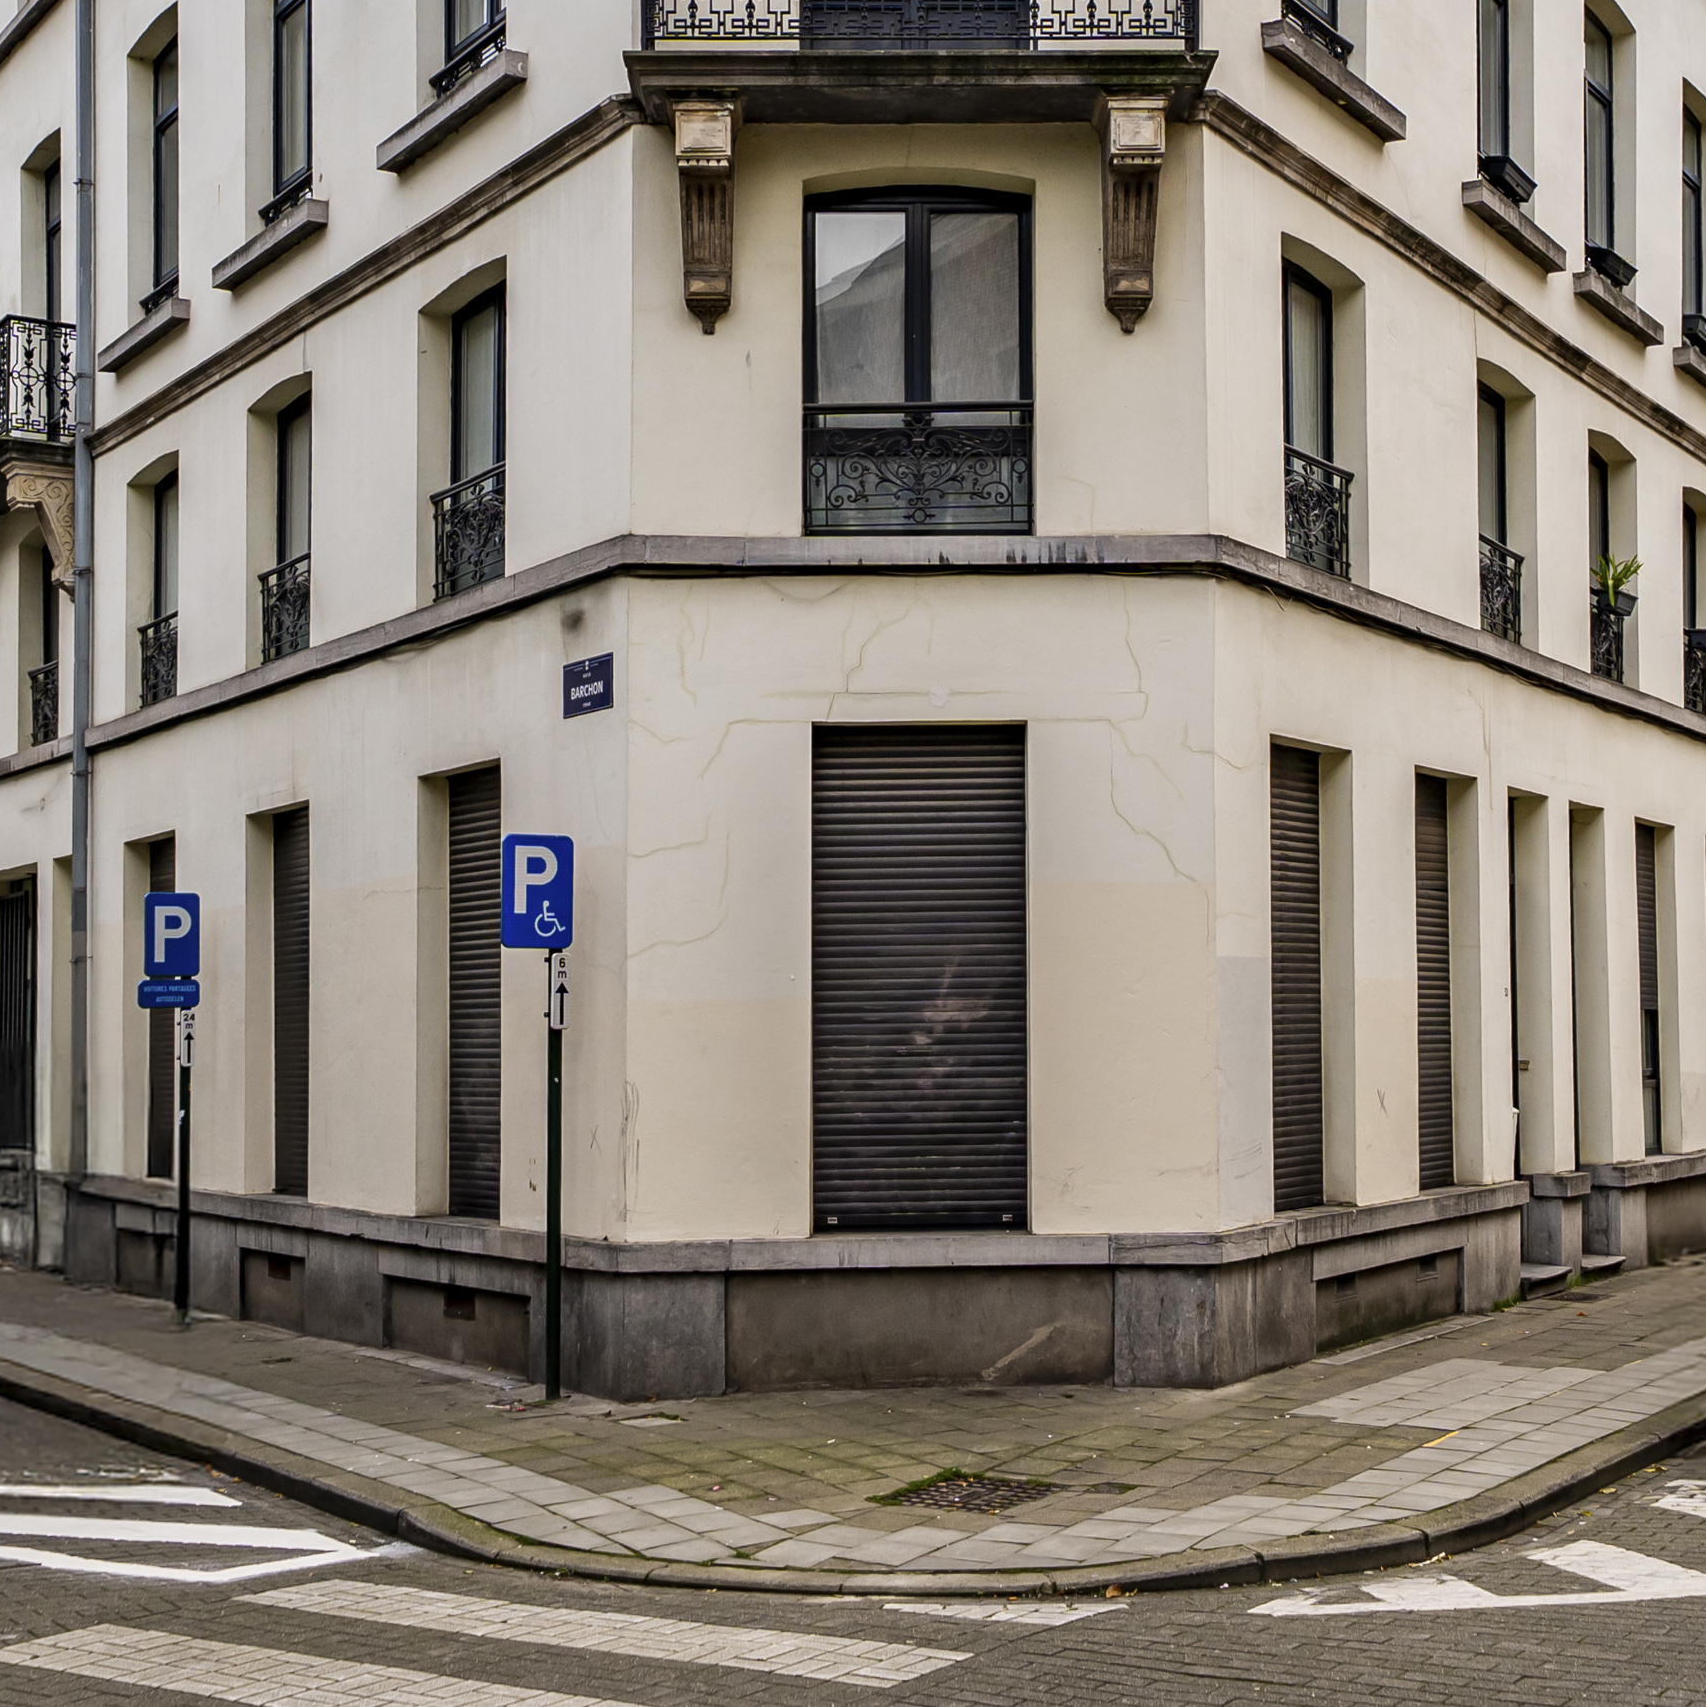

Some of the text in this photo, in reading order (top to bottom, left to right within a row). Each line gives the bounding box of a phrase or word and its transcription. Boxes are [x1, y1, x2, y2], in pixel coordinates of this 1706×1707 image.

[570, 680, 604, 700] BARCHON
[514, 845, 558, 914] P
[154, 906, 192, 963] P
[559, 957, 566, 968] 6
[558, 969, 567, 979] m
[183, 1013, 196, 1022] 24
[185, 1022, 193, 1030] m
